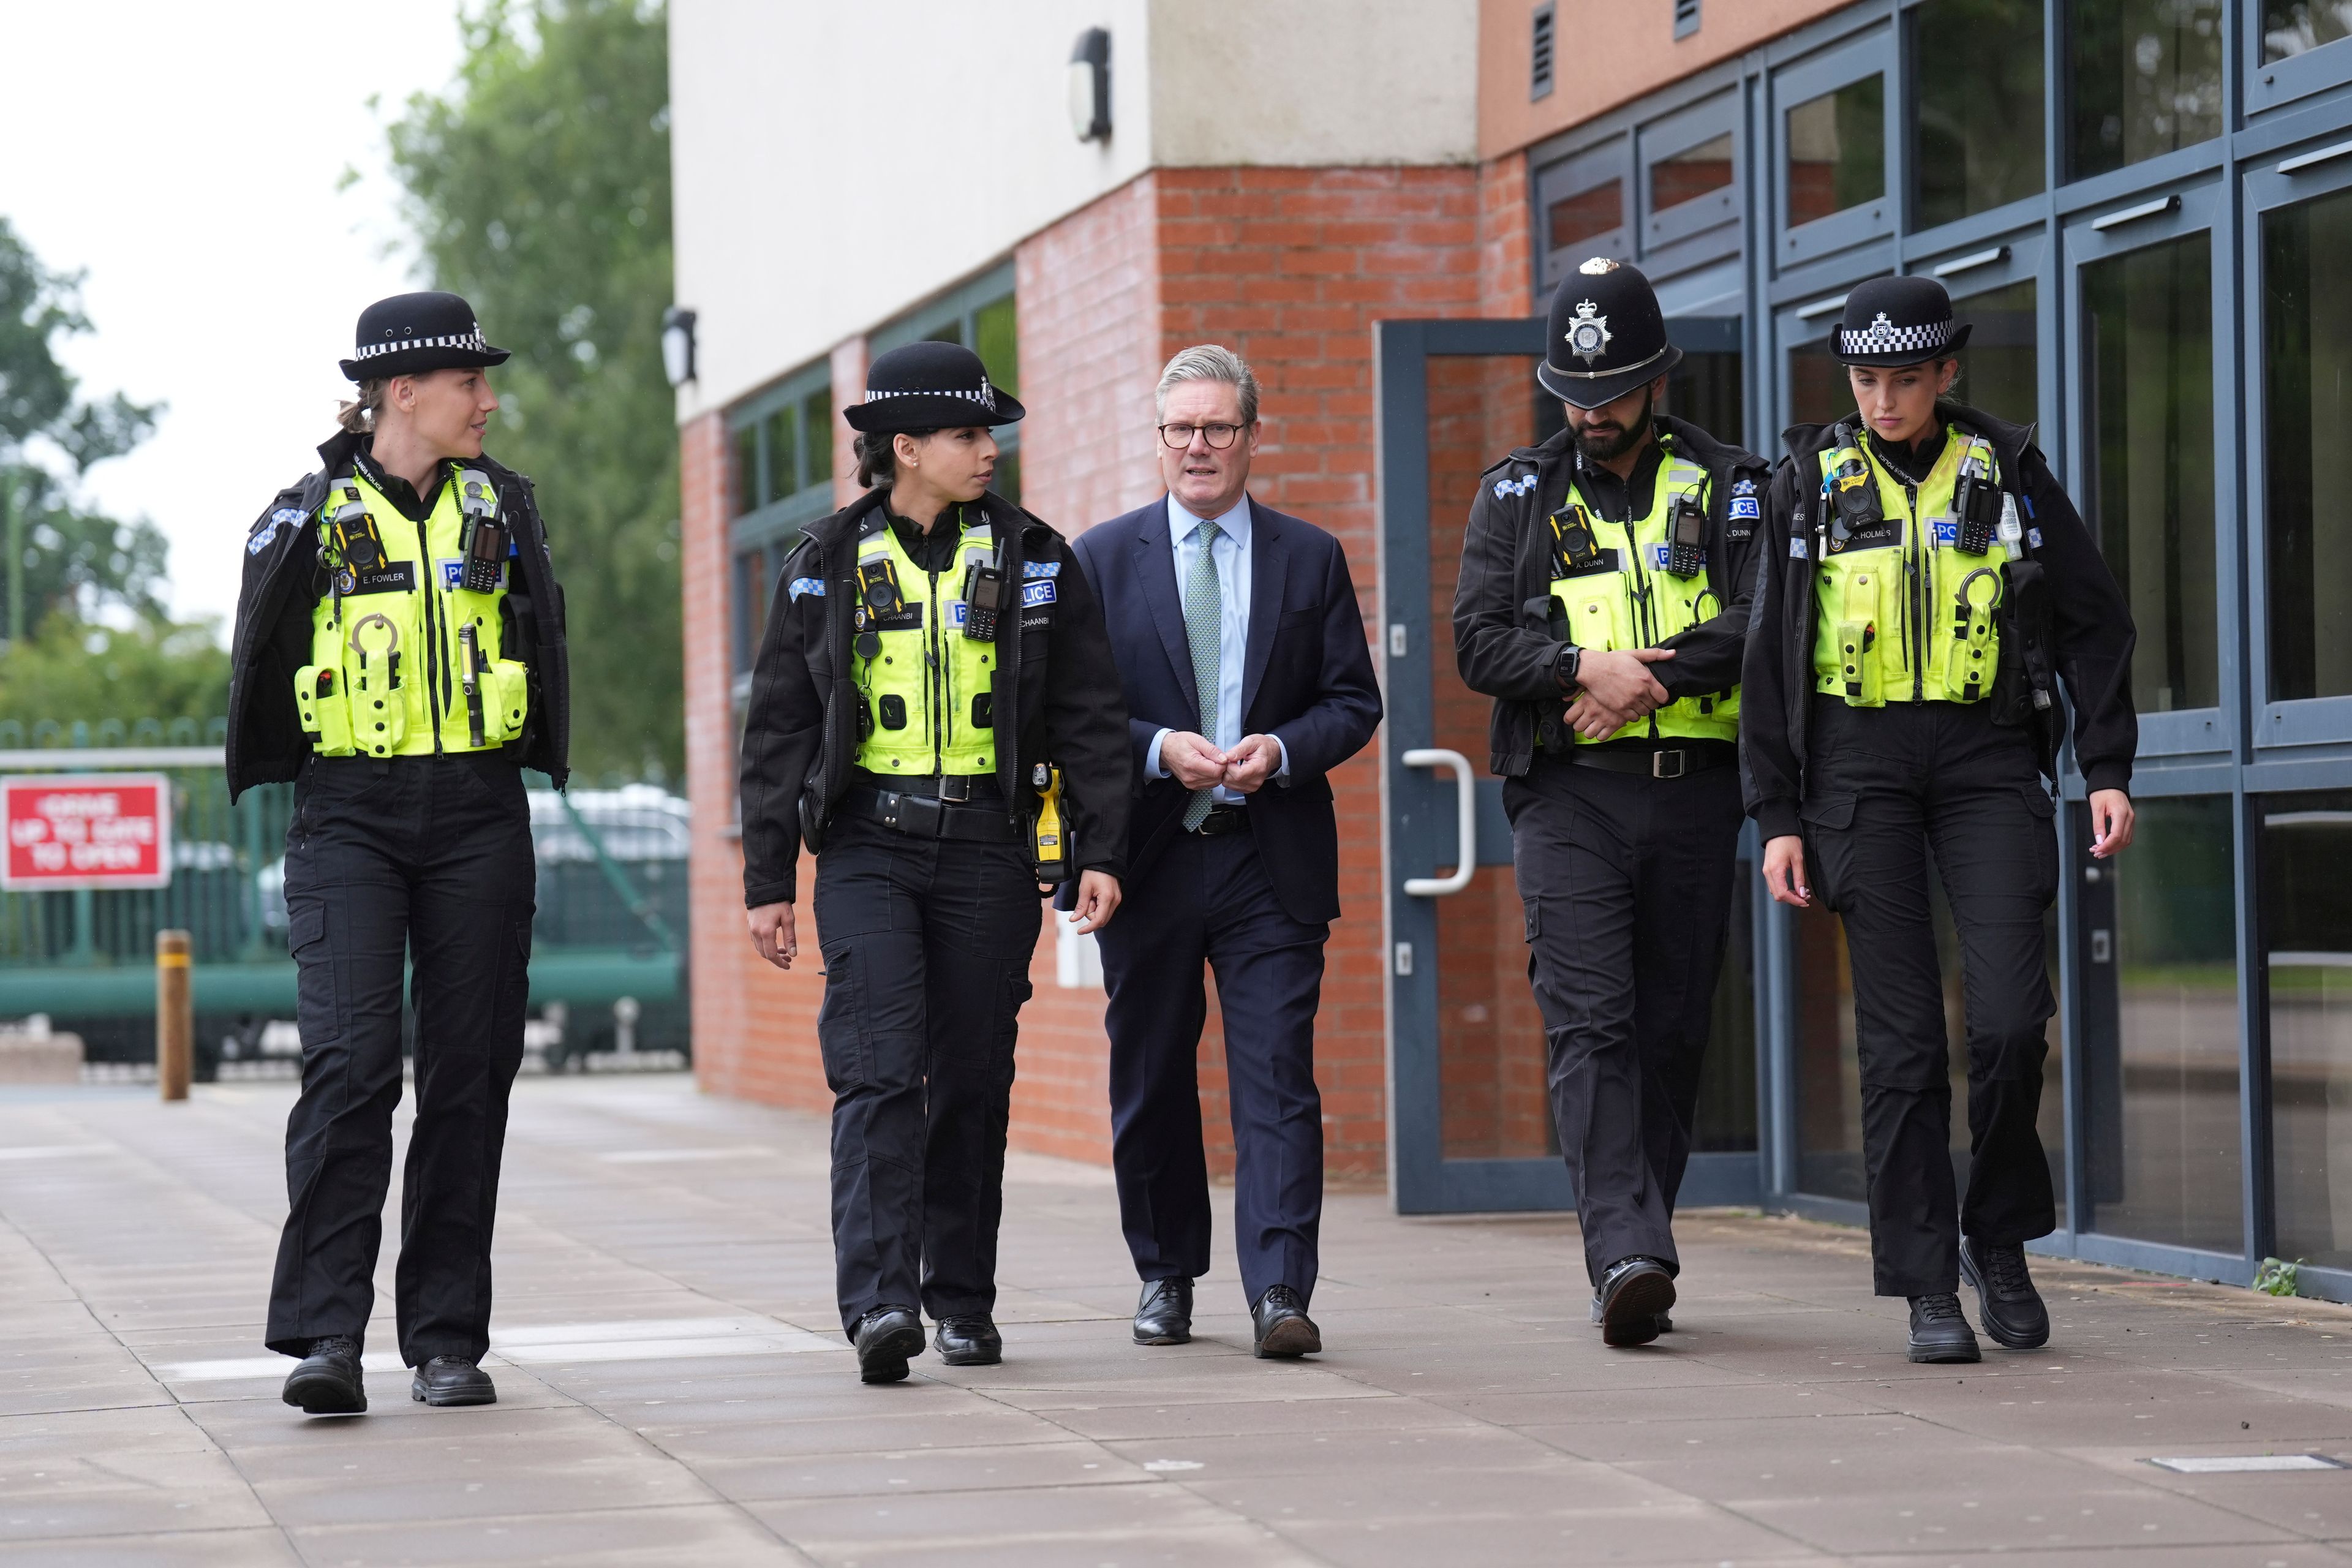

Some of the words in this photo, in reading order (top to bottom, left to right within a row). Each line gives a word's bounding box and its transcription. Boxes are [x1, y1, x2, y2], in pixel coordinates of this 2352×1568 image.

[1878, 453, 1895, 470] POLICE
[366, 473, 383, 491] POLICE
[1894, 467, 1918, 486] IDLANDS
[1594, 509, 1605, 521] WES
[1860, 529, 1891, 539] HOLMES
[1584, 559, 1604, 568] DUNN
[372, 573, 405, 583] FOWLER
[1022, 585, 1052, 603] LICE
[1021, 617, 1049, 627] CHAANBI
[32, 843, 67, 870] TO
[70, 842, 140, 870] OPEN
